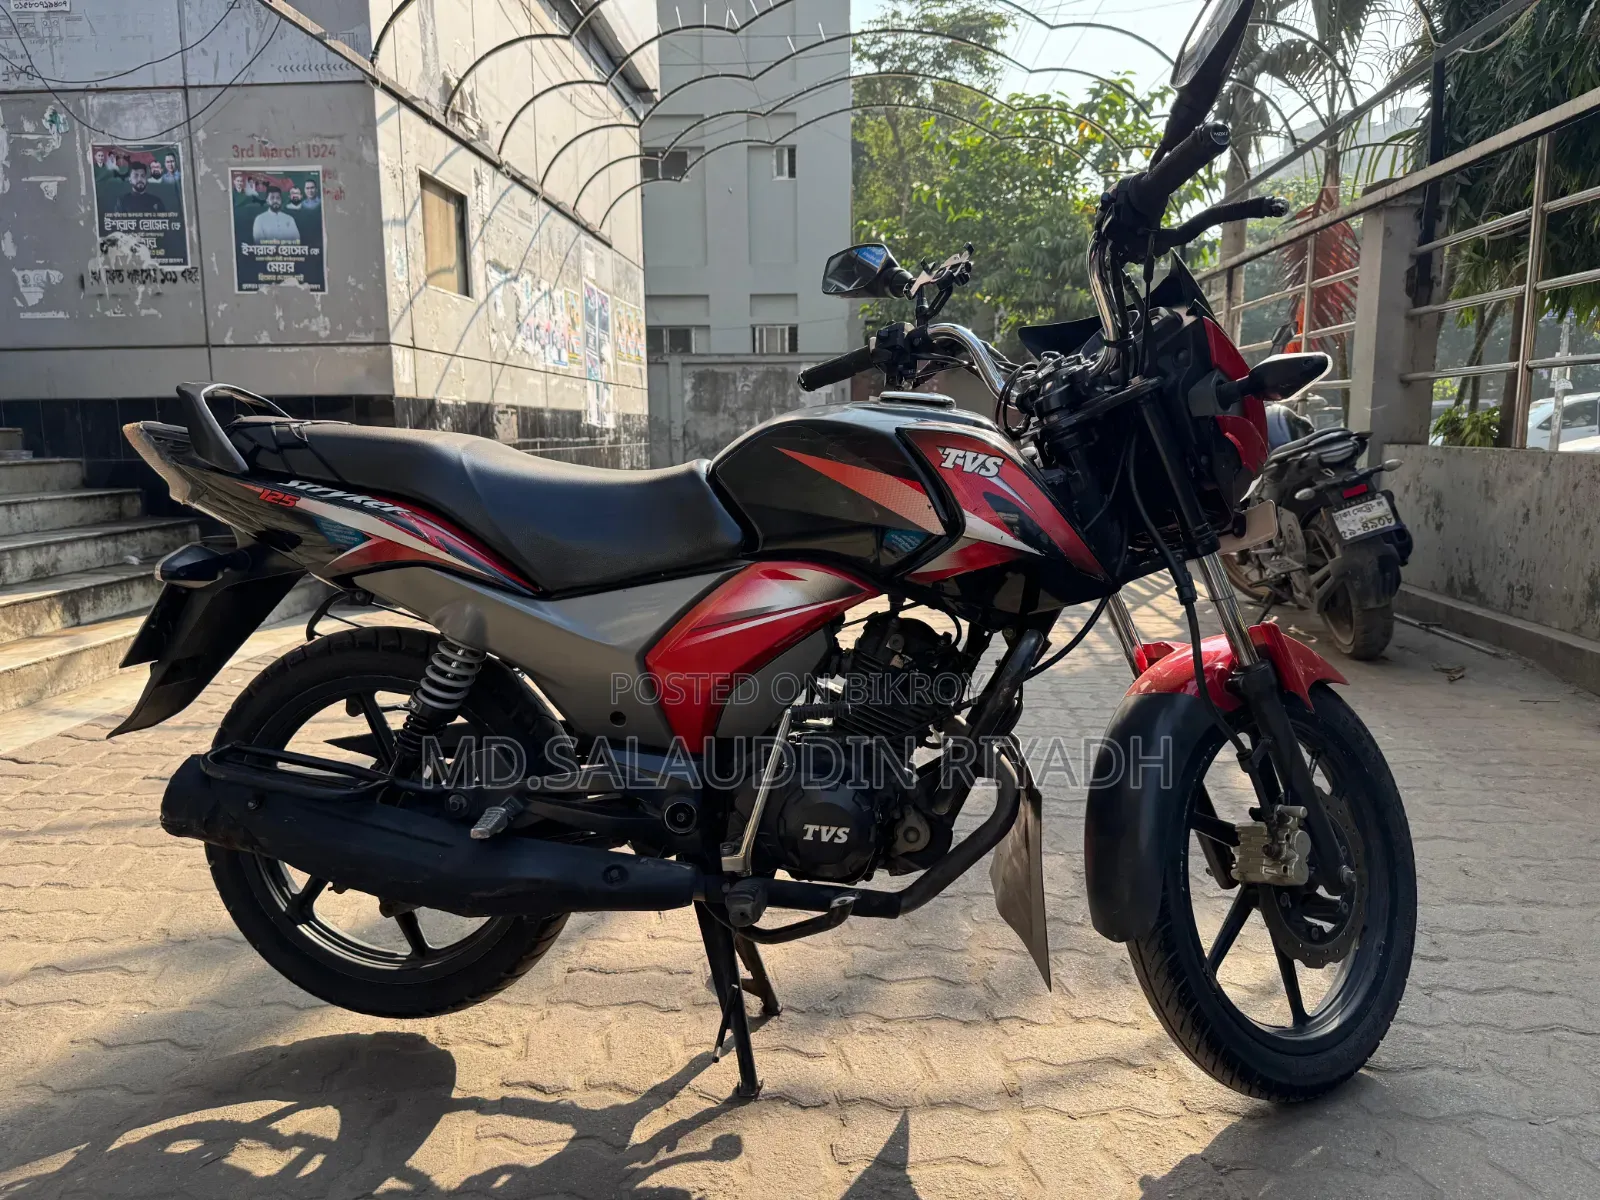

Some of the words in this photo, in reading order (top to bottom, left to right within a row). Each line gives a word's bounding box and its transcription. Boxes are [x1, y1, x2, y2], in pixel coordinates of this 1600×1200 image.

[232, 144, 254, 158] 3rd
[260, 144, 300, 158] March
[307, 144, 336, 158] 1924
[104, 217, 137, 231] ইশরাক
[139, 219, 170, 231] হোসেন
[241, 242, 277, 256] ইশরাক
[278, 245, 309, 256] হোসেন
[266, 261, 295, 274] মেয়র
[160, 268, 178, 284] ১০১
[936, 446, 1006, 478] TVS
[259, 490, 301, 508] 125
[803, 823, 850, 844] TVS
